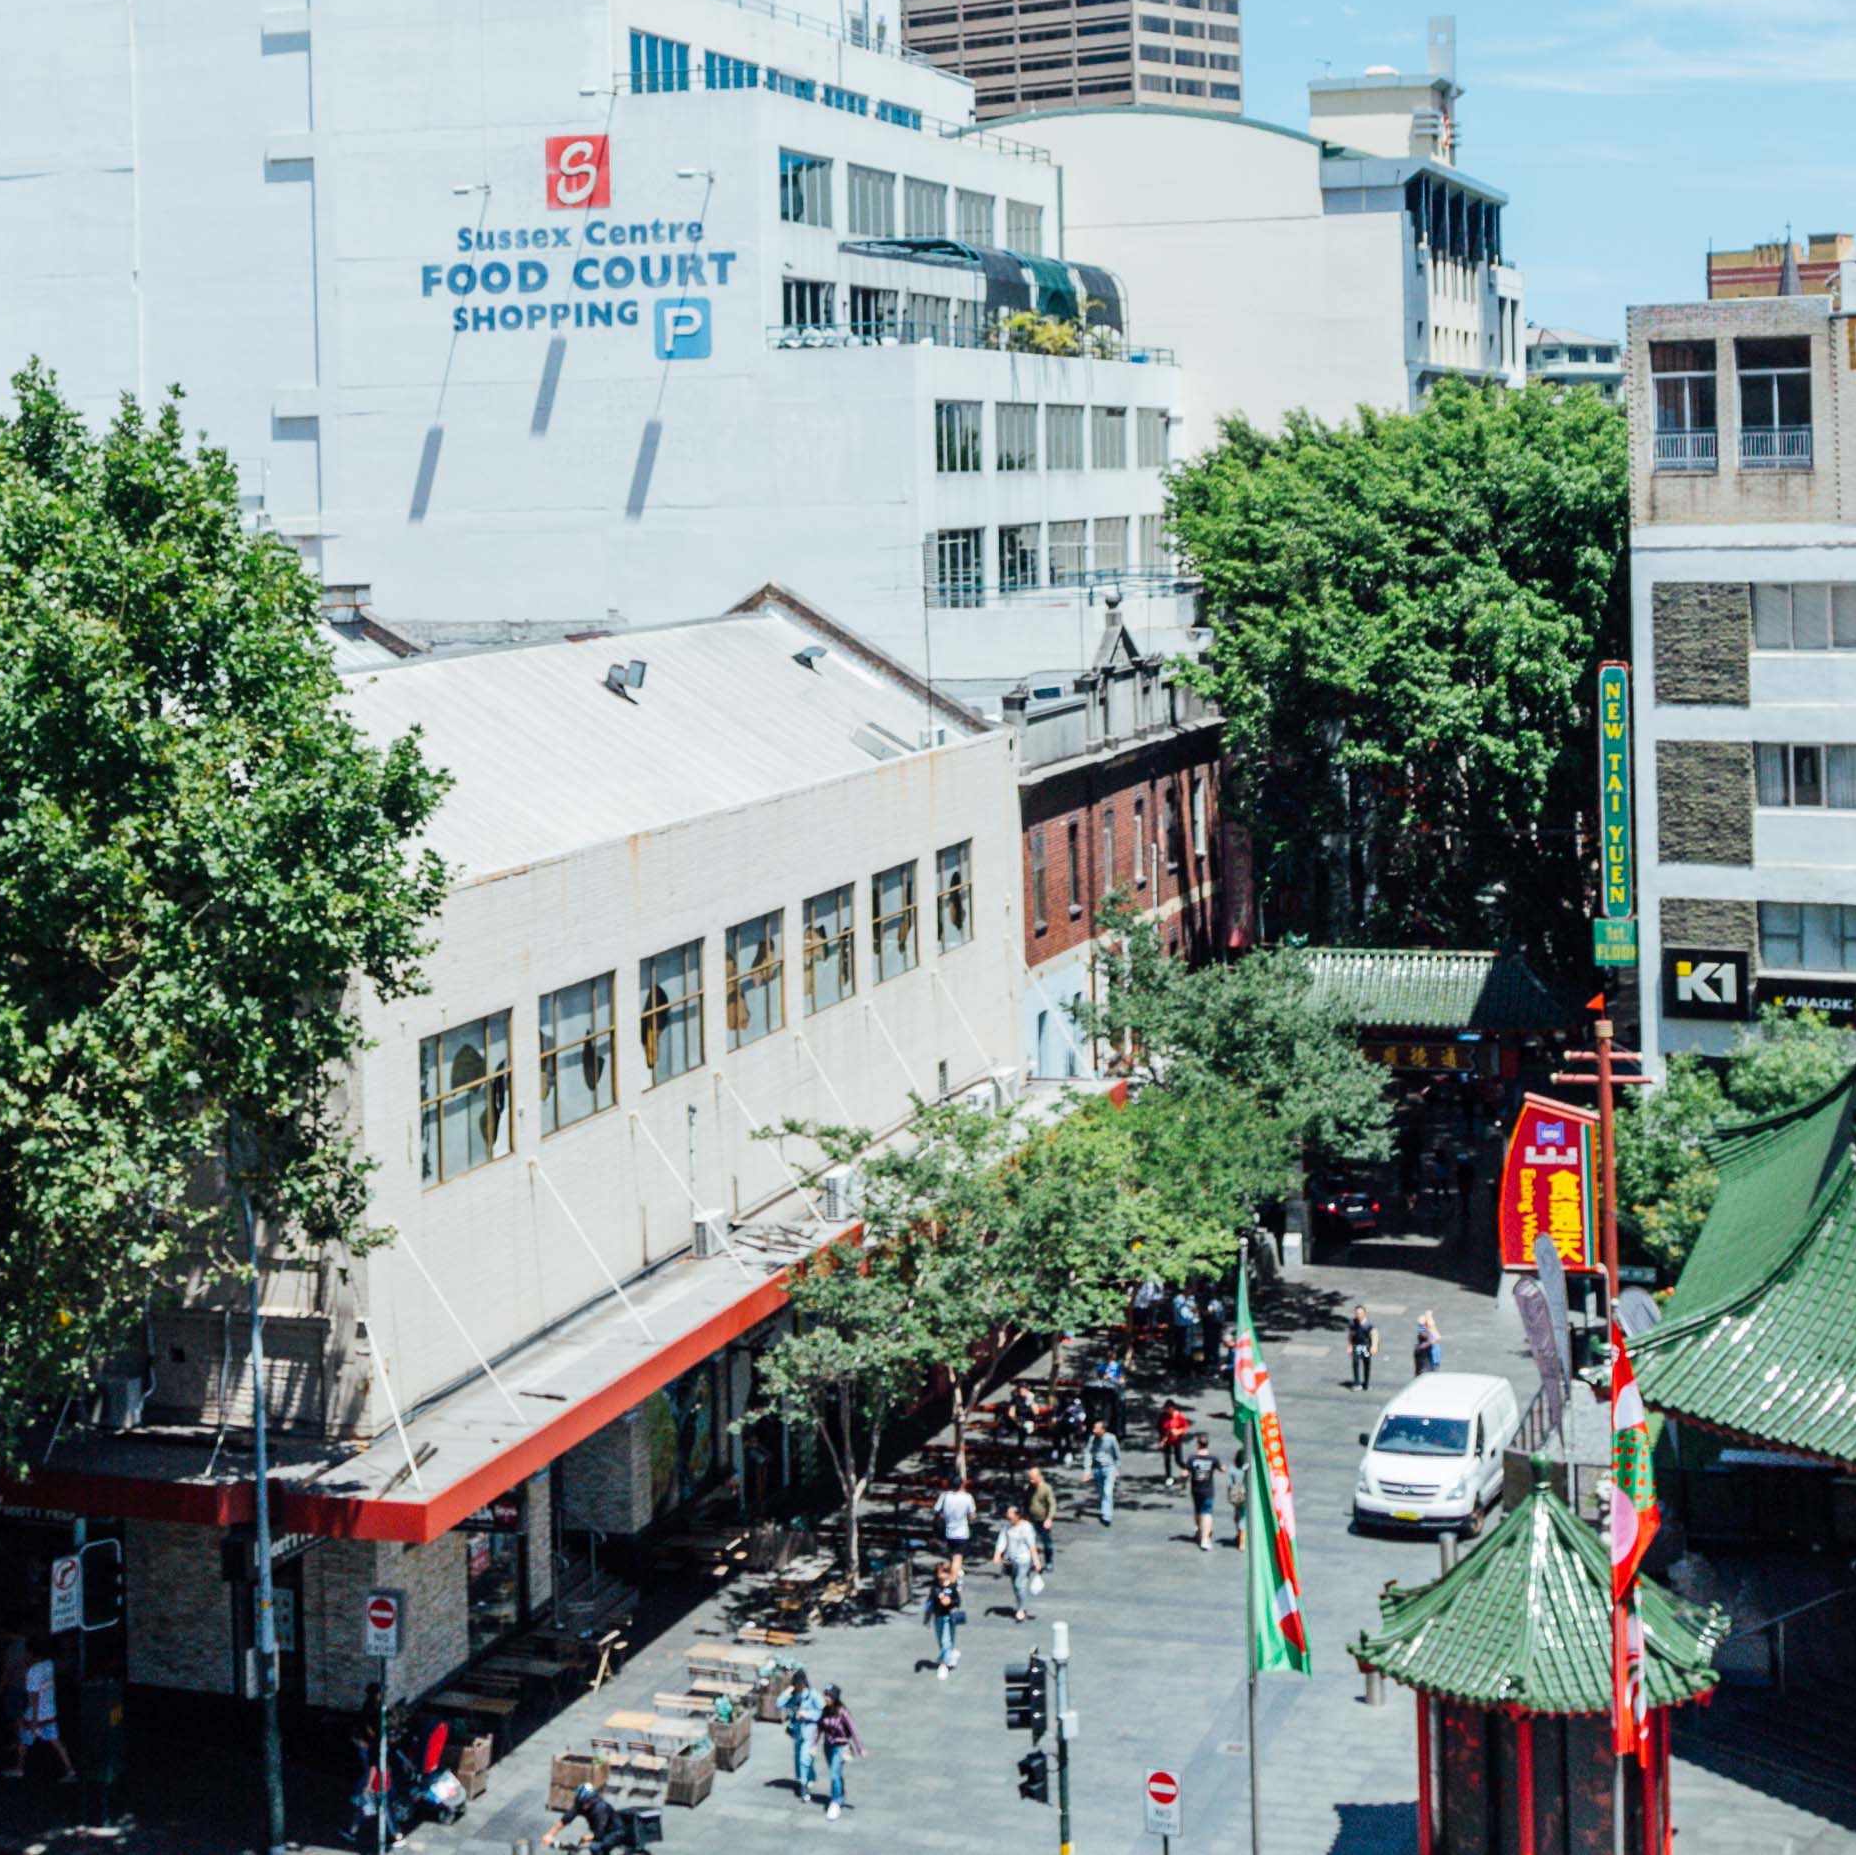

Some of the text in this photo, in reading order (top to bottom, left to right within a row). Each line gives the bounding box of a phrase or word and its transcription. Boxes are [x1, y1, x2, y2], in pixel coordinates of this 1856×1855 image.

[557, 142, 597, 205] S
[457, 217, 704, 252] Sussex Centre
[421, 251, 737, 297] FOOD COURT
[453, 301, 639, 333] SHOPPING
[663, 306, 702, 352] P
[1605, 682, 1626, 904] NEW TAI YUEN
[1676, 961, 1737, 1004] K1
[1773, 994, 1854, 1012] KARAOKE
[1517, 1168, 1539, 1263] Eating World
